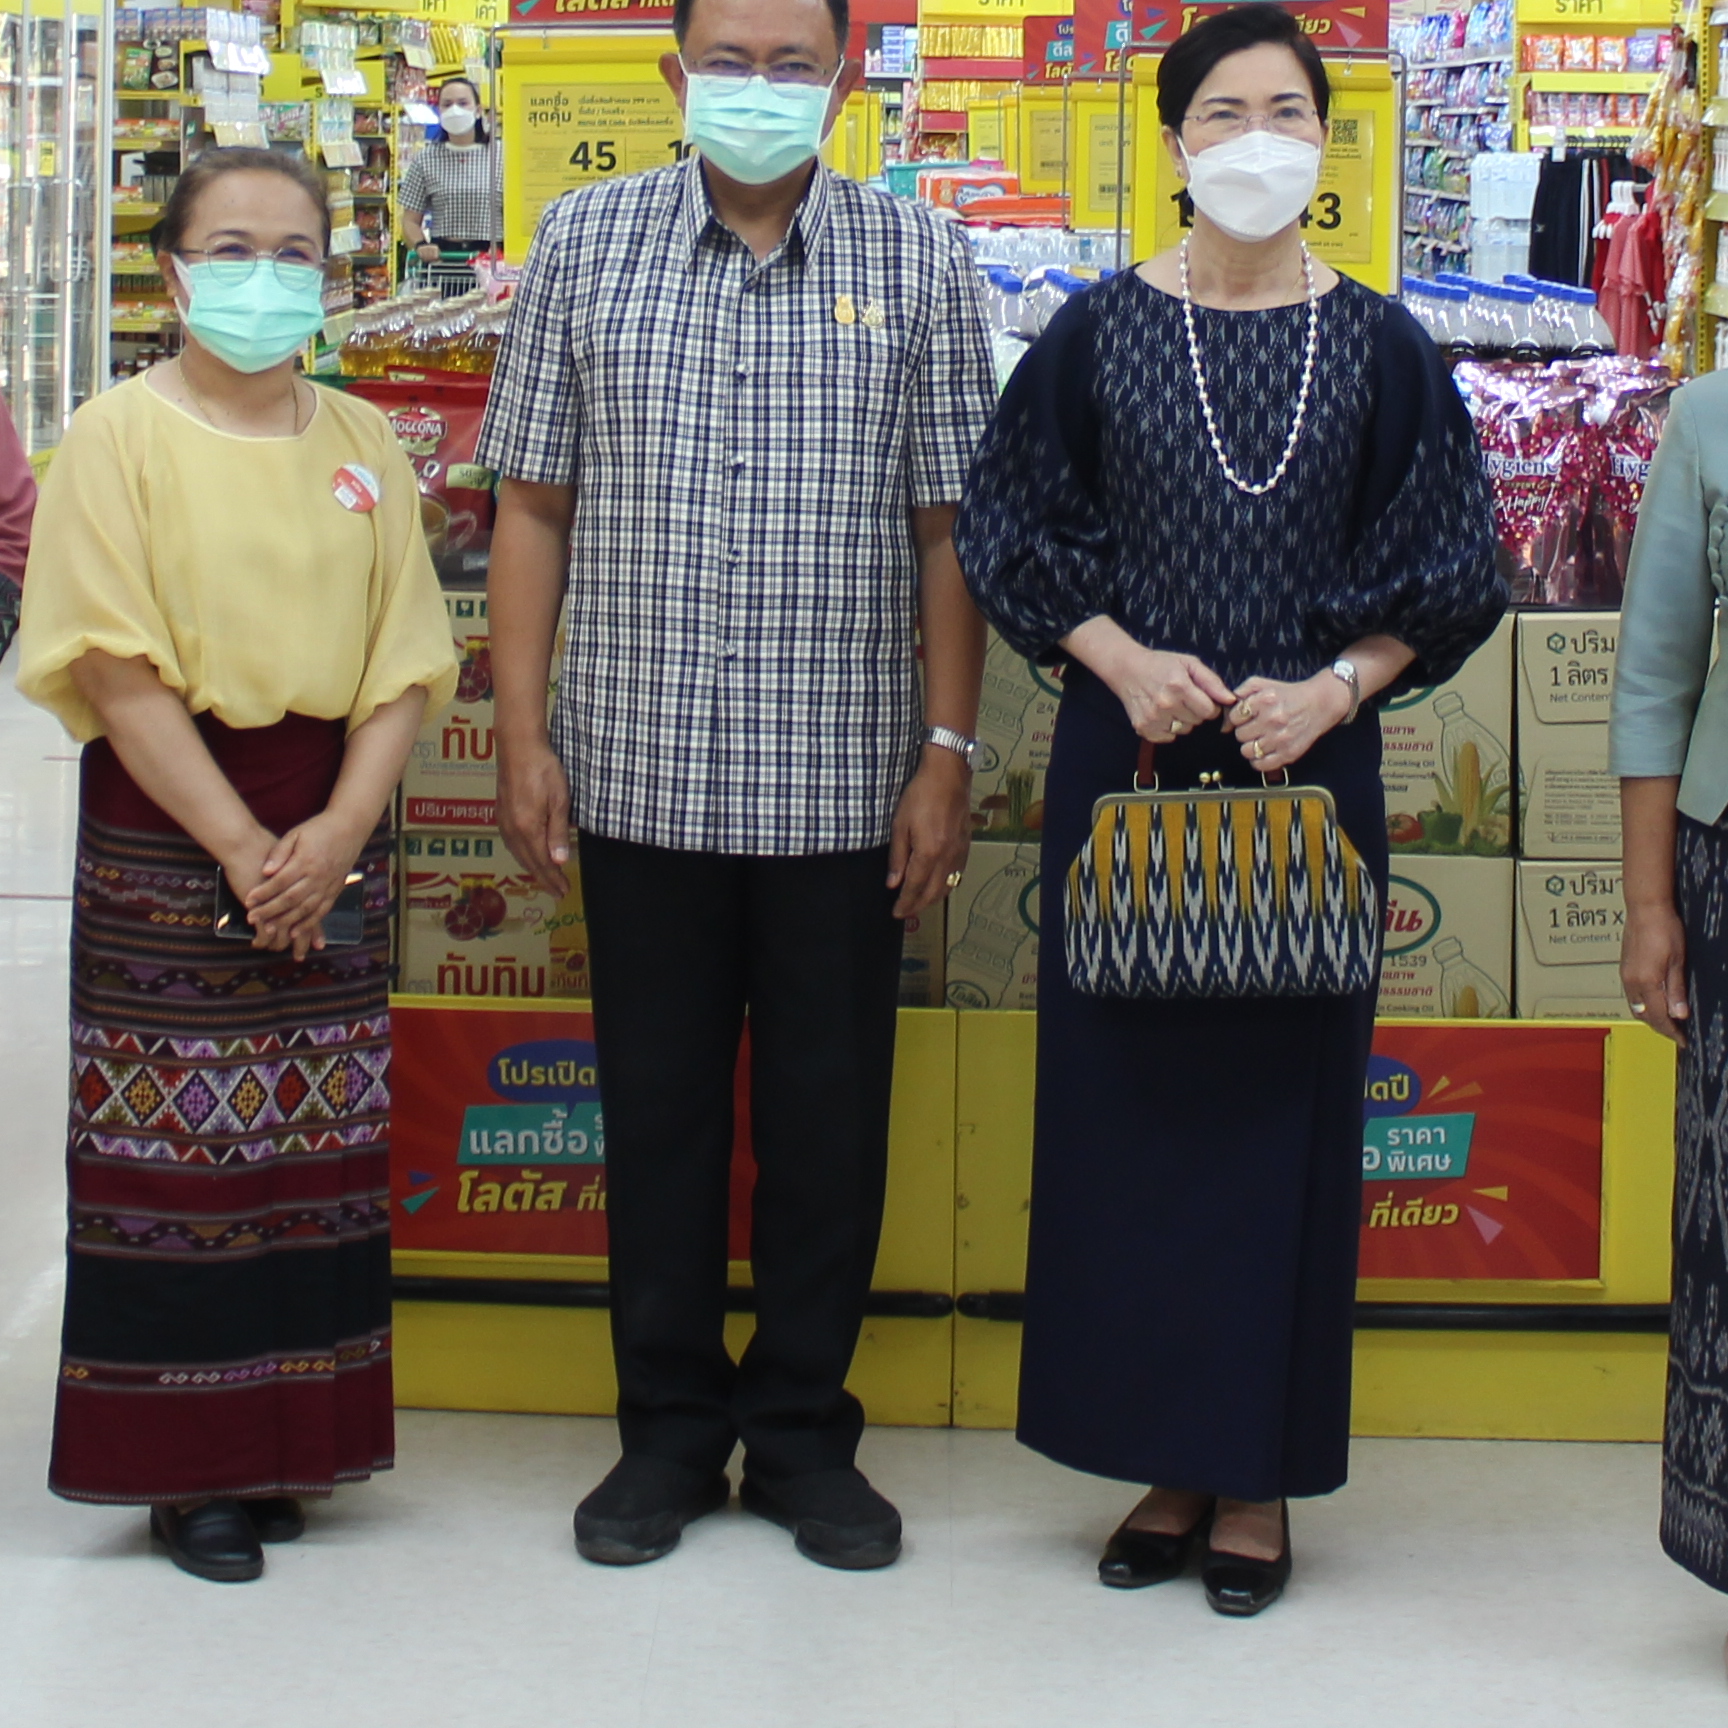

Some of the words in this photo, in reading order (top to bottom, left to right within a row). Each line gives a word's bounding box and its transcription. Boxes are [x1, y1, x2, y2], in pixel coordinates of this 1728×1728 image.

[530, 90, 570, 107] แลกซื้อ
[528, 107, 572, 128] สุดคุ้ม
[569, 140, 617, 172] 45
[1551, 666, 1561, 688] 1
[1568, 659, 1609, 687] ลิตร
[1549, 692, 1568, 703] Net
[1387, 759, 1420, 770] Cooking
[1550, 907, 1560, 929] 1
[1566, 901, 1607, 928] ลิตร
[1549, 933, 1568, 944] Net
[1570, 932, 1611, 944] Content
[437, 952, 546, 997] ทับทิม
[1386, 1003, 1418, 1015] Cooking
[469, 1107, 589, 1156] แลกซื้อ
[1386, 1125, 1447, 1145] ราคา
[1386, 1147, 1453, 1173] พิเศษ
[456, 1169, 569, 1214] โลตัส
[1368, 1189, 1461, 1229] ที่เดียว
